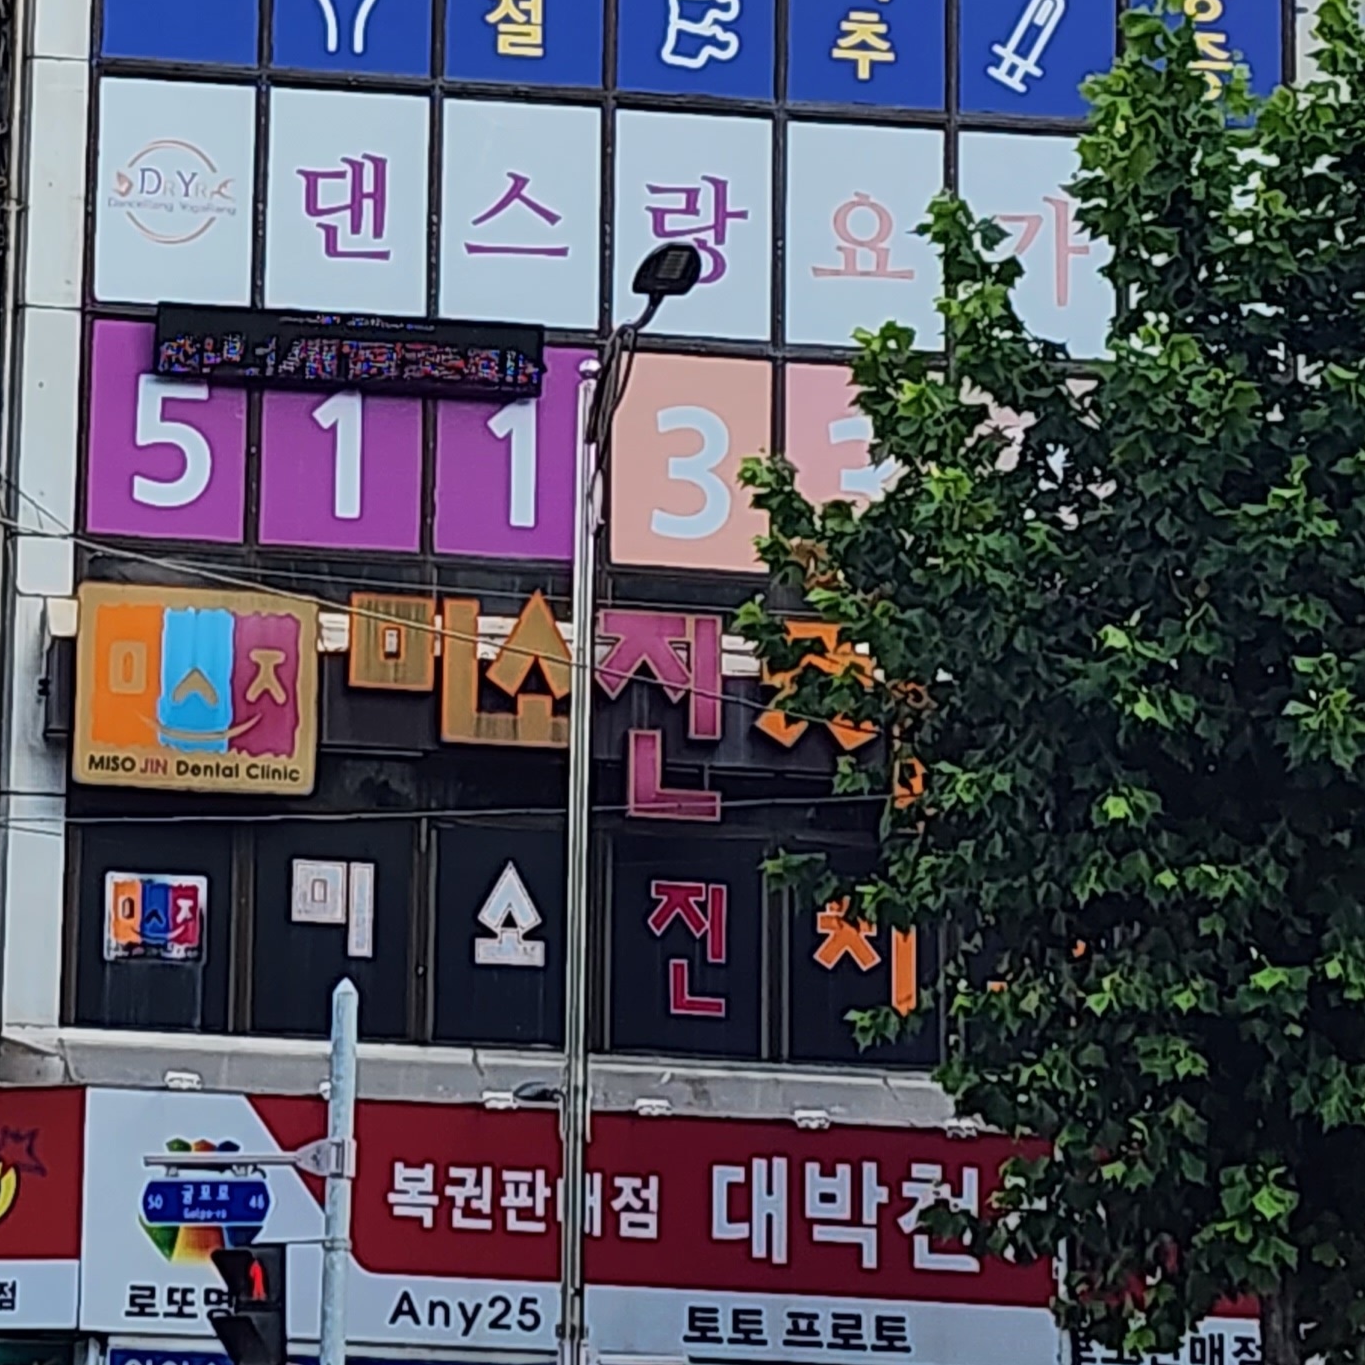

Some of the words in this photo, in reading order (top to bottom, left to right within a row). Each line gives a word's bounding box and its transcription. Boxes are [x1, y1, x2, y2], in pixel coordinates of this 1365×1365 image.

[88, 754, 136, 772] MISO
[140, 758, 168, 775] JIN
[176, 760, 240, 778] Dental
[246, 763, 301, 782] Clinic
[389, 1289, 543, 1336] Any25
[682, 1305, 771, 1348] 토토
[783, 1310, 913, 1354] 프로토
